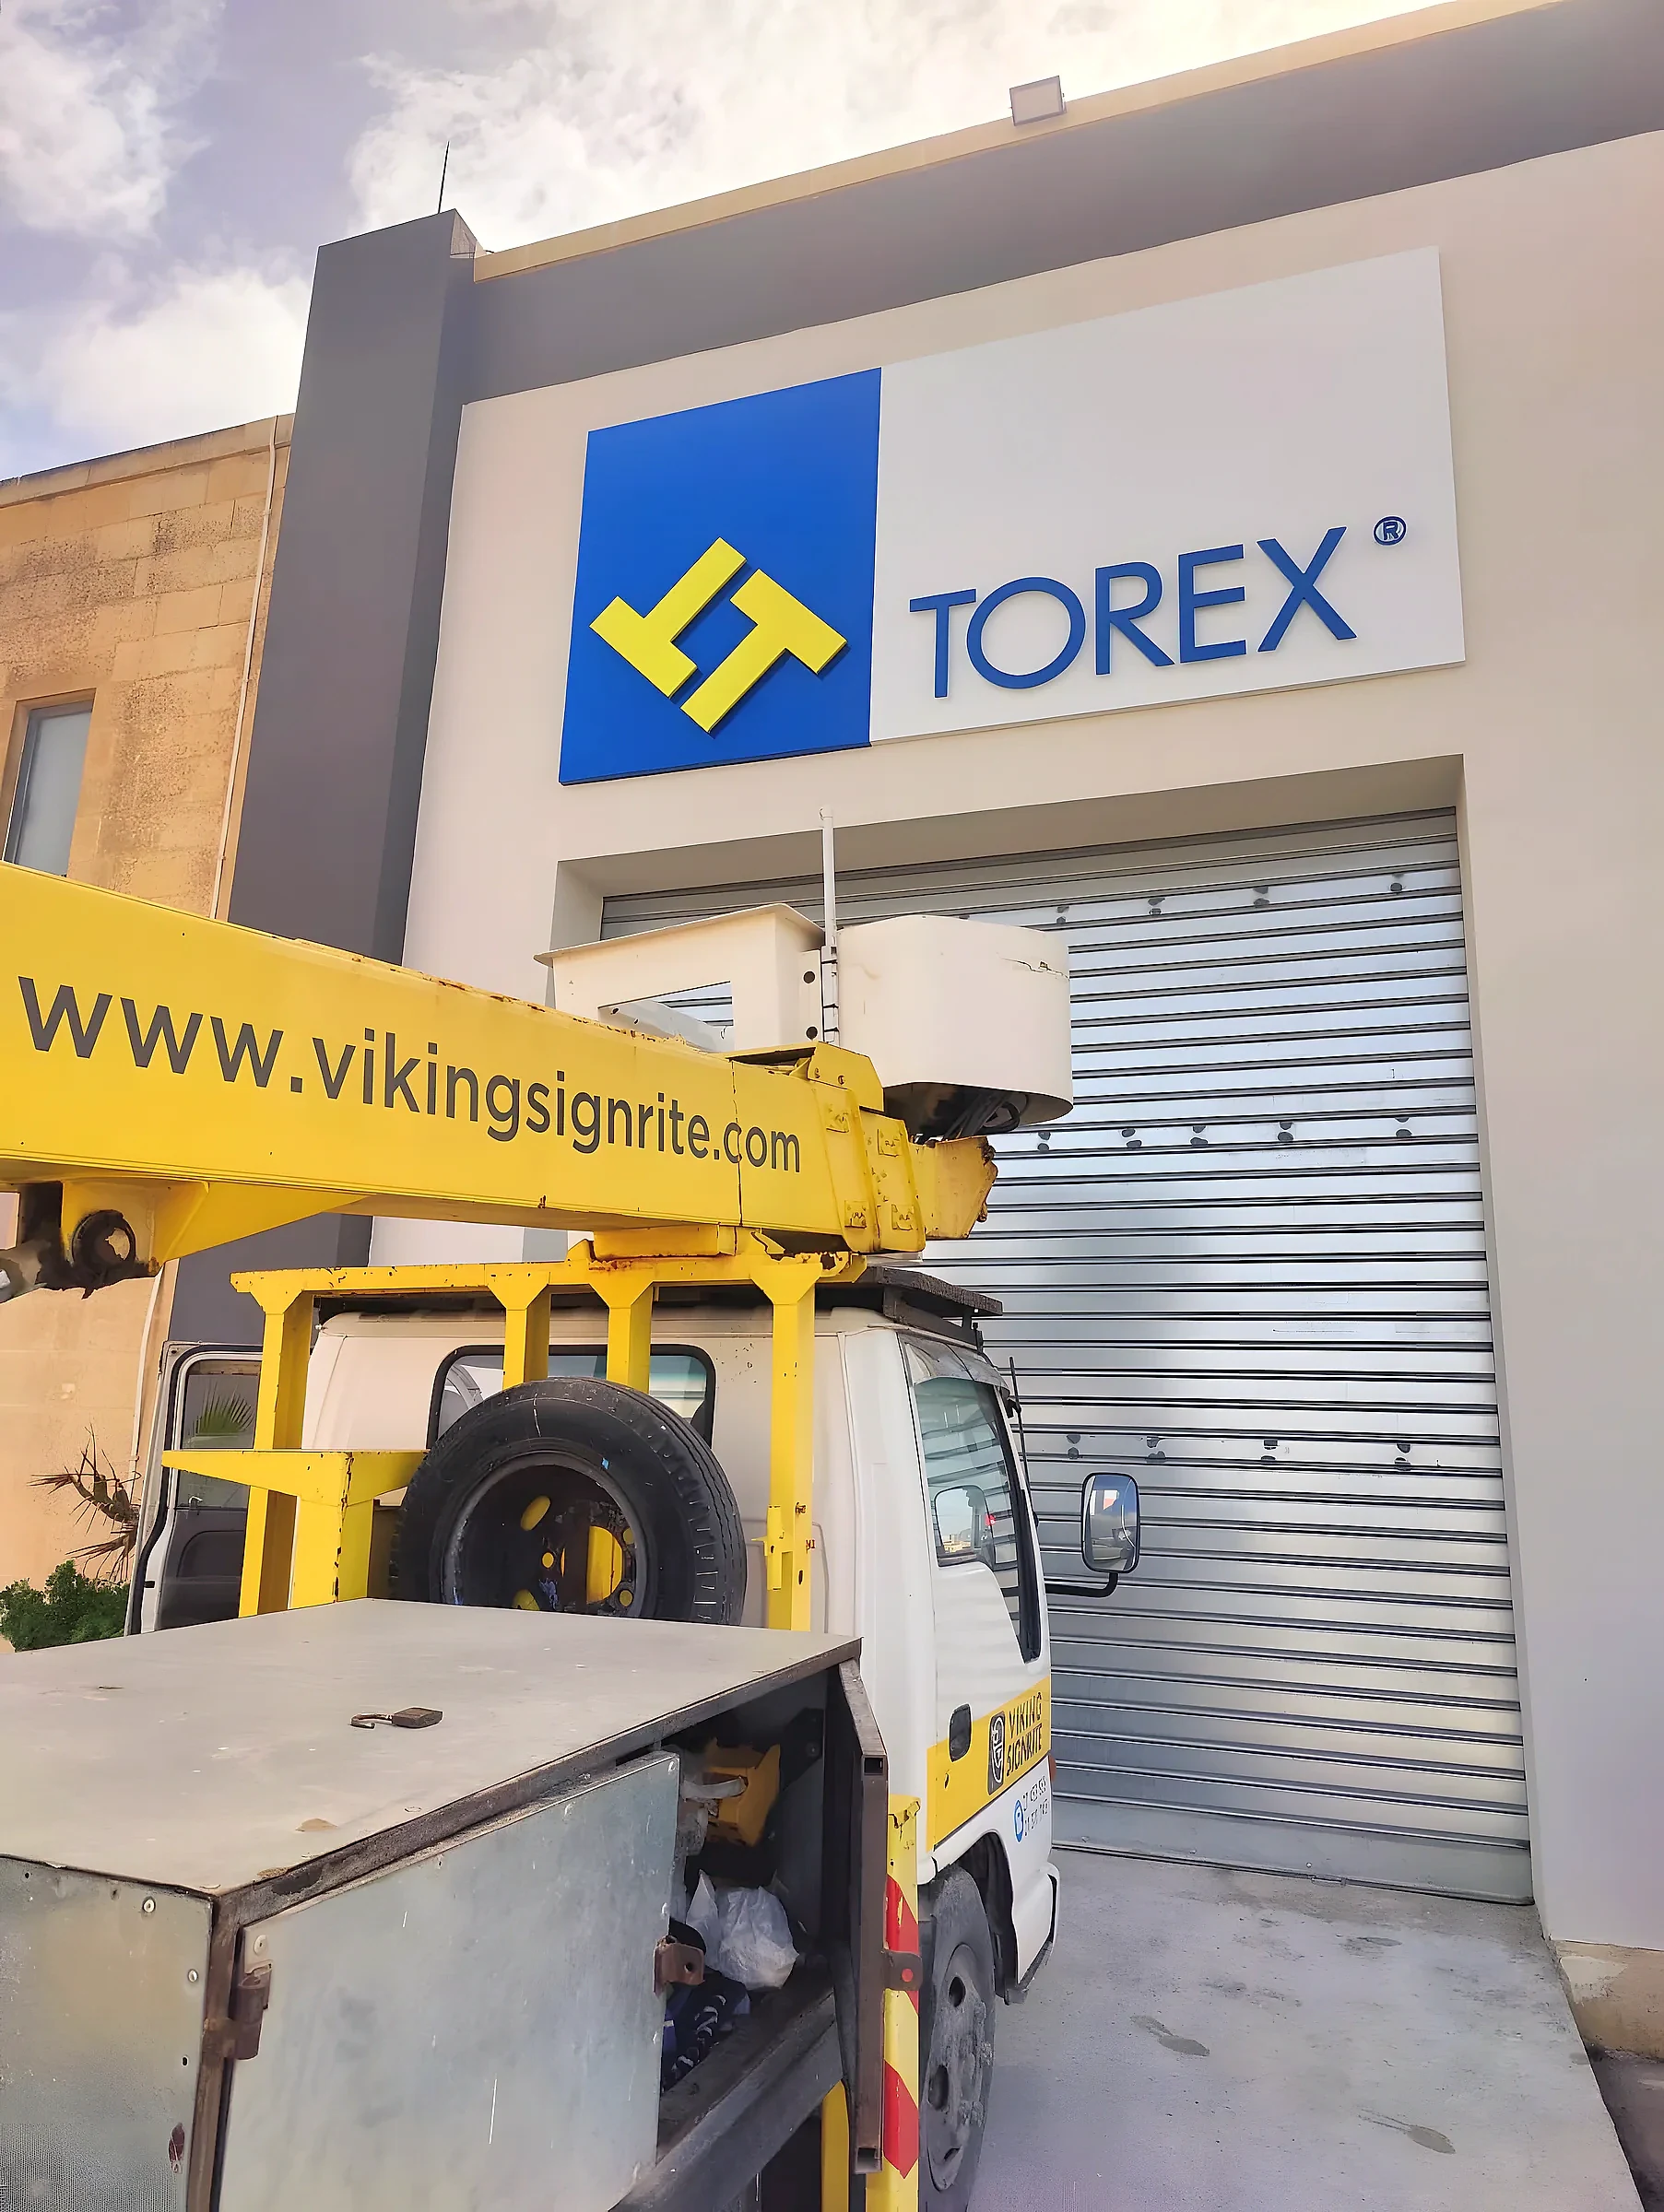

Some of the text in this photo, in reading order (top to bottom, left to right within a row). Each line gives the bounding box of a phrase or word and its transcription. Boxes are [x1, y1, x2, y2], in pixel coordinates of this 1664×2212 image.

[909, 525, 1358, 699] TOREX
[18, 975, 801, 1174] www.vikingsignrite.com
[1009, 1691, 1043, 1739] VIKING
